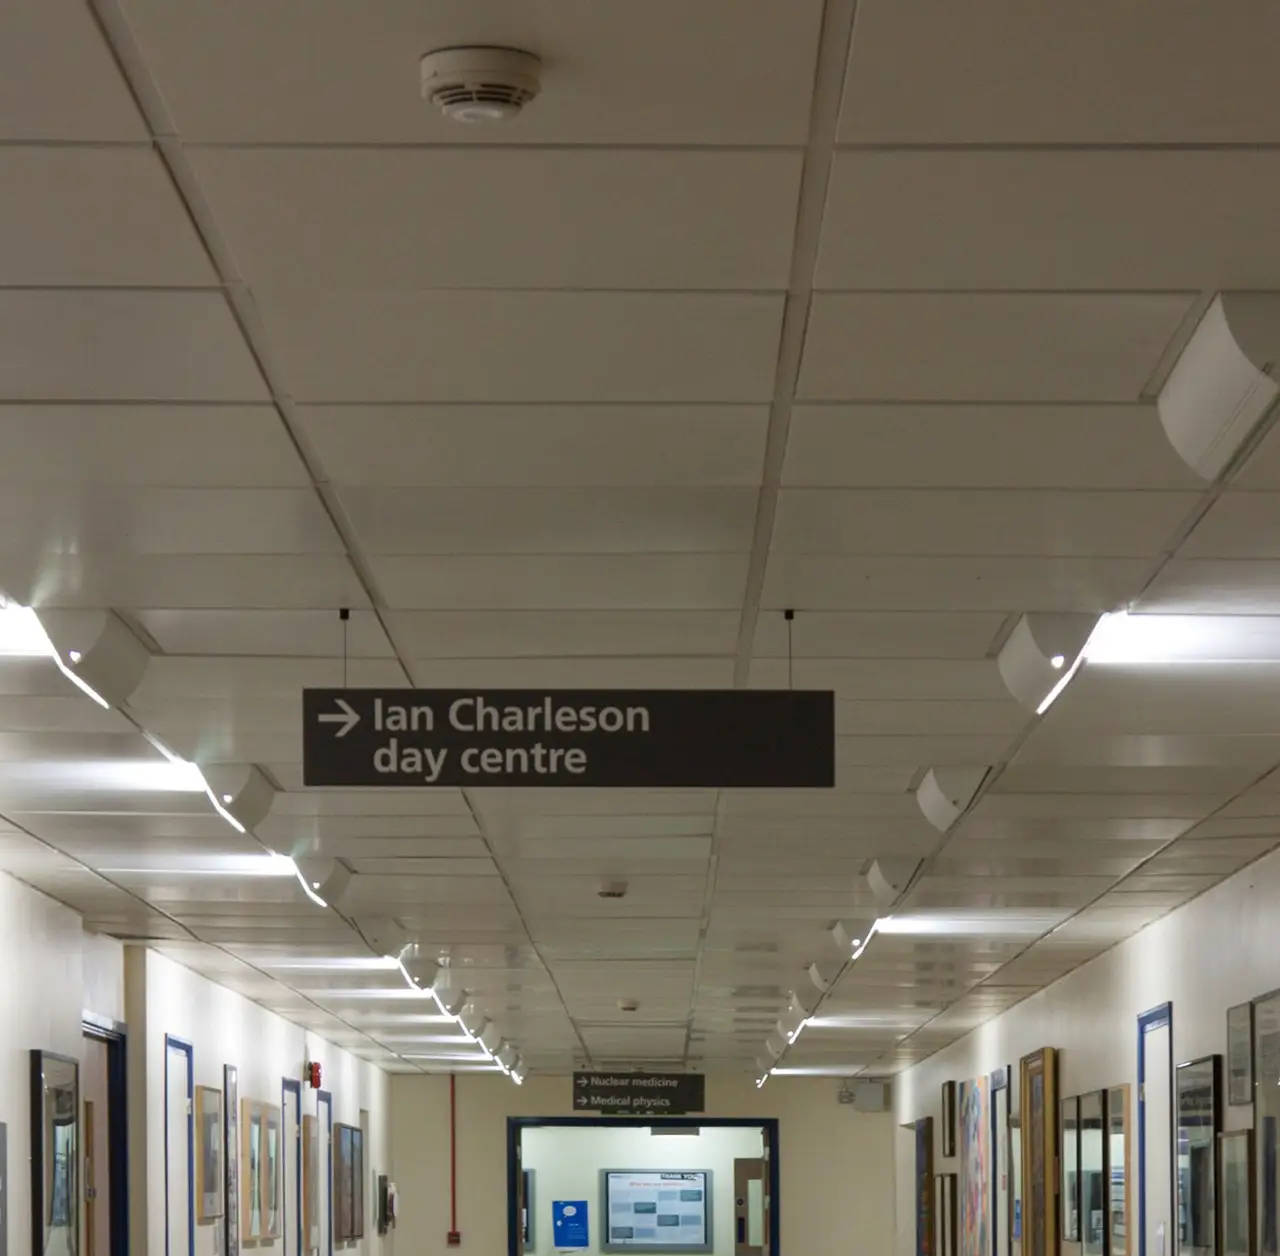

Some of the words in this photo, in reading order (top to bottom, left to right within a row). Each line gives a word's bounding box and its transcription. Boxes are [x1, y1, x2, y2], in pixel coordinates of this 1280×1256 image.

[373, 697, 434, 732] Ian
[448, 697, 650, 732] Charleson
[373, 737, 447, 781] day
[460, 743, 588, 774] centre
[590, 1076, 630, 1087] Nuclear
[631, 1077, 679, 1088] medicine
[590, 1095, 631, 1106] Medical
[632, 1095, 671, 1108] physics
